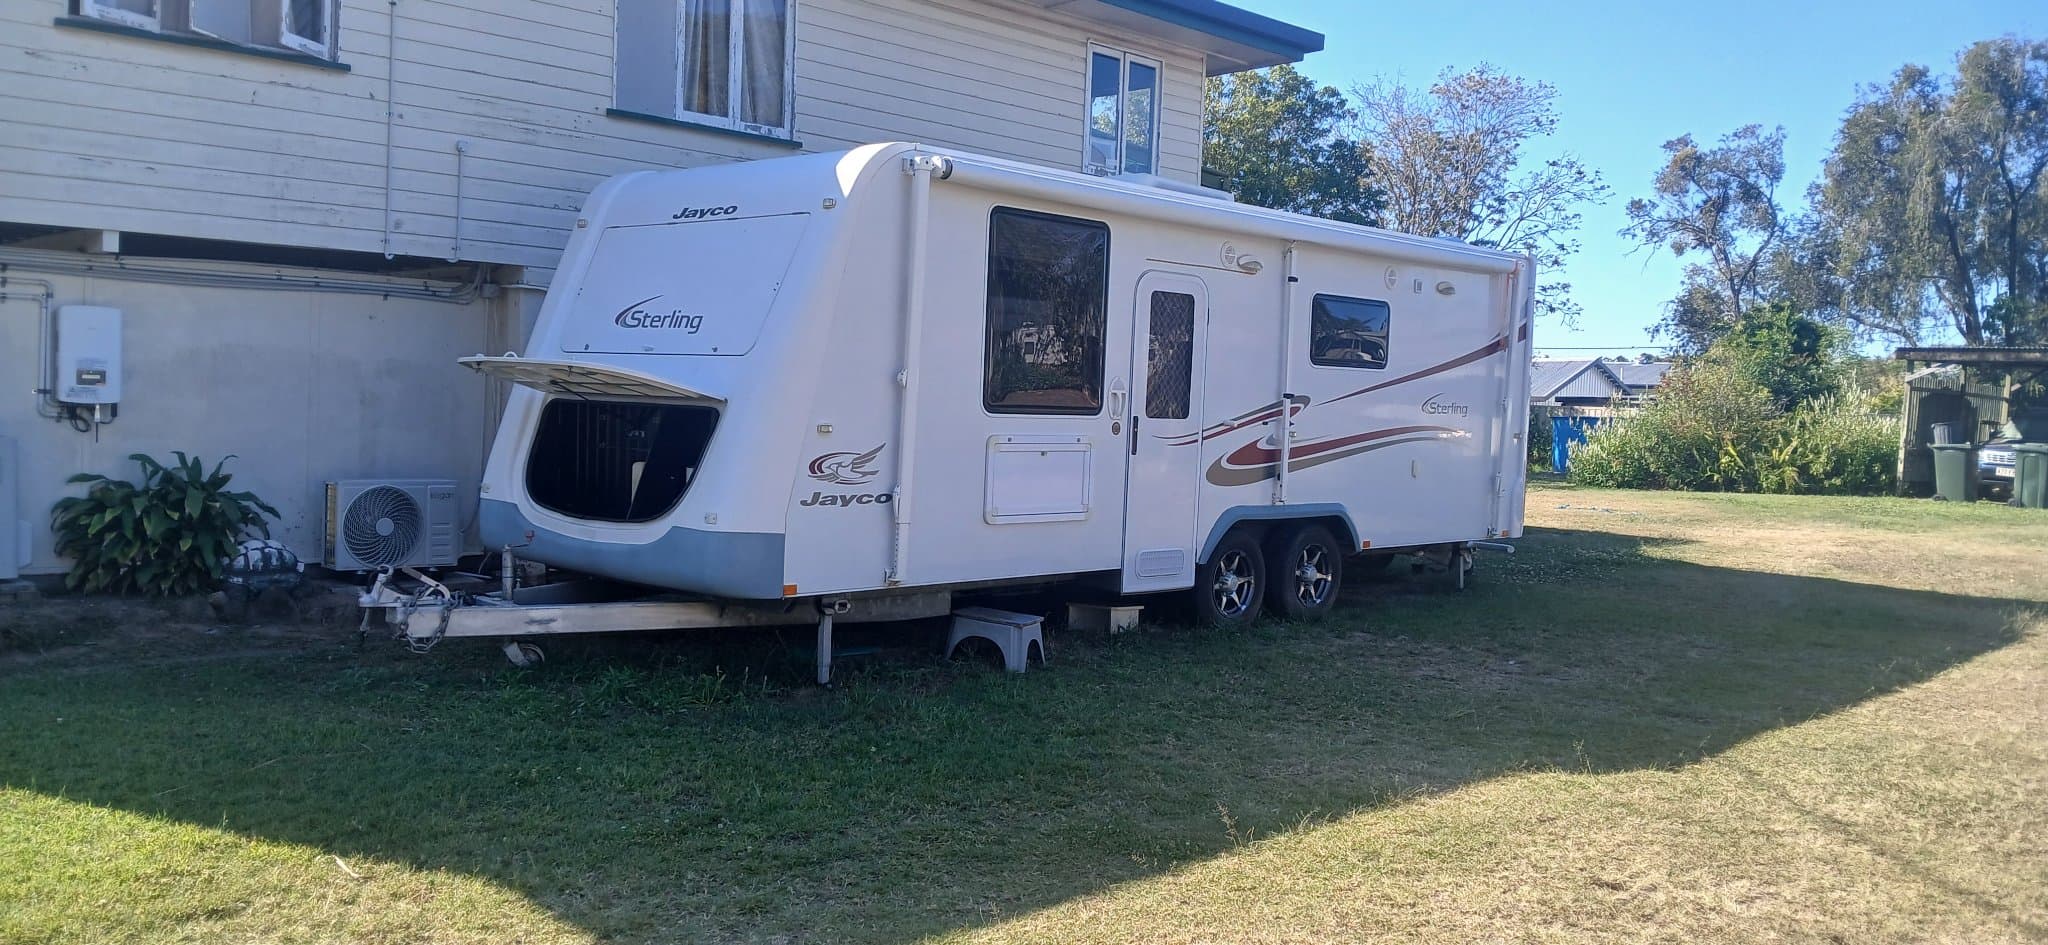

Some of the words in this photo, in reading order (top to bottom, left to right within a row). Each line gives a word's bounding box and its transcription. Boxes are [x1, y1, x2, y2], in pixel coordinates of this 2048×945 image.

[672, 205, 738, 219] Jayco
[622, 308, 704, 335] Sterling
[1426, 401, 1469, 418] Sterling
[800, 491, 893, 508] Jayco
